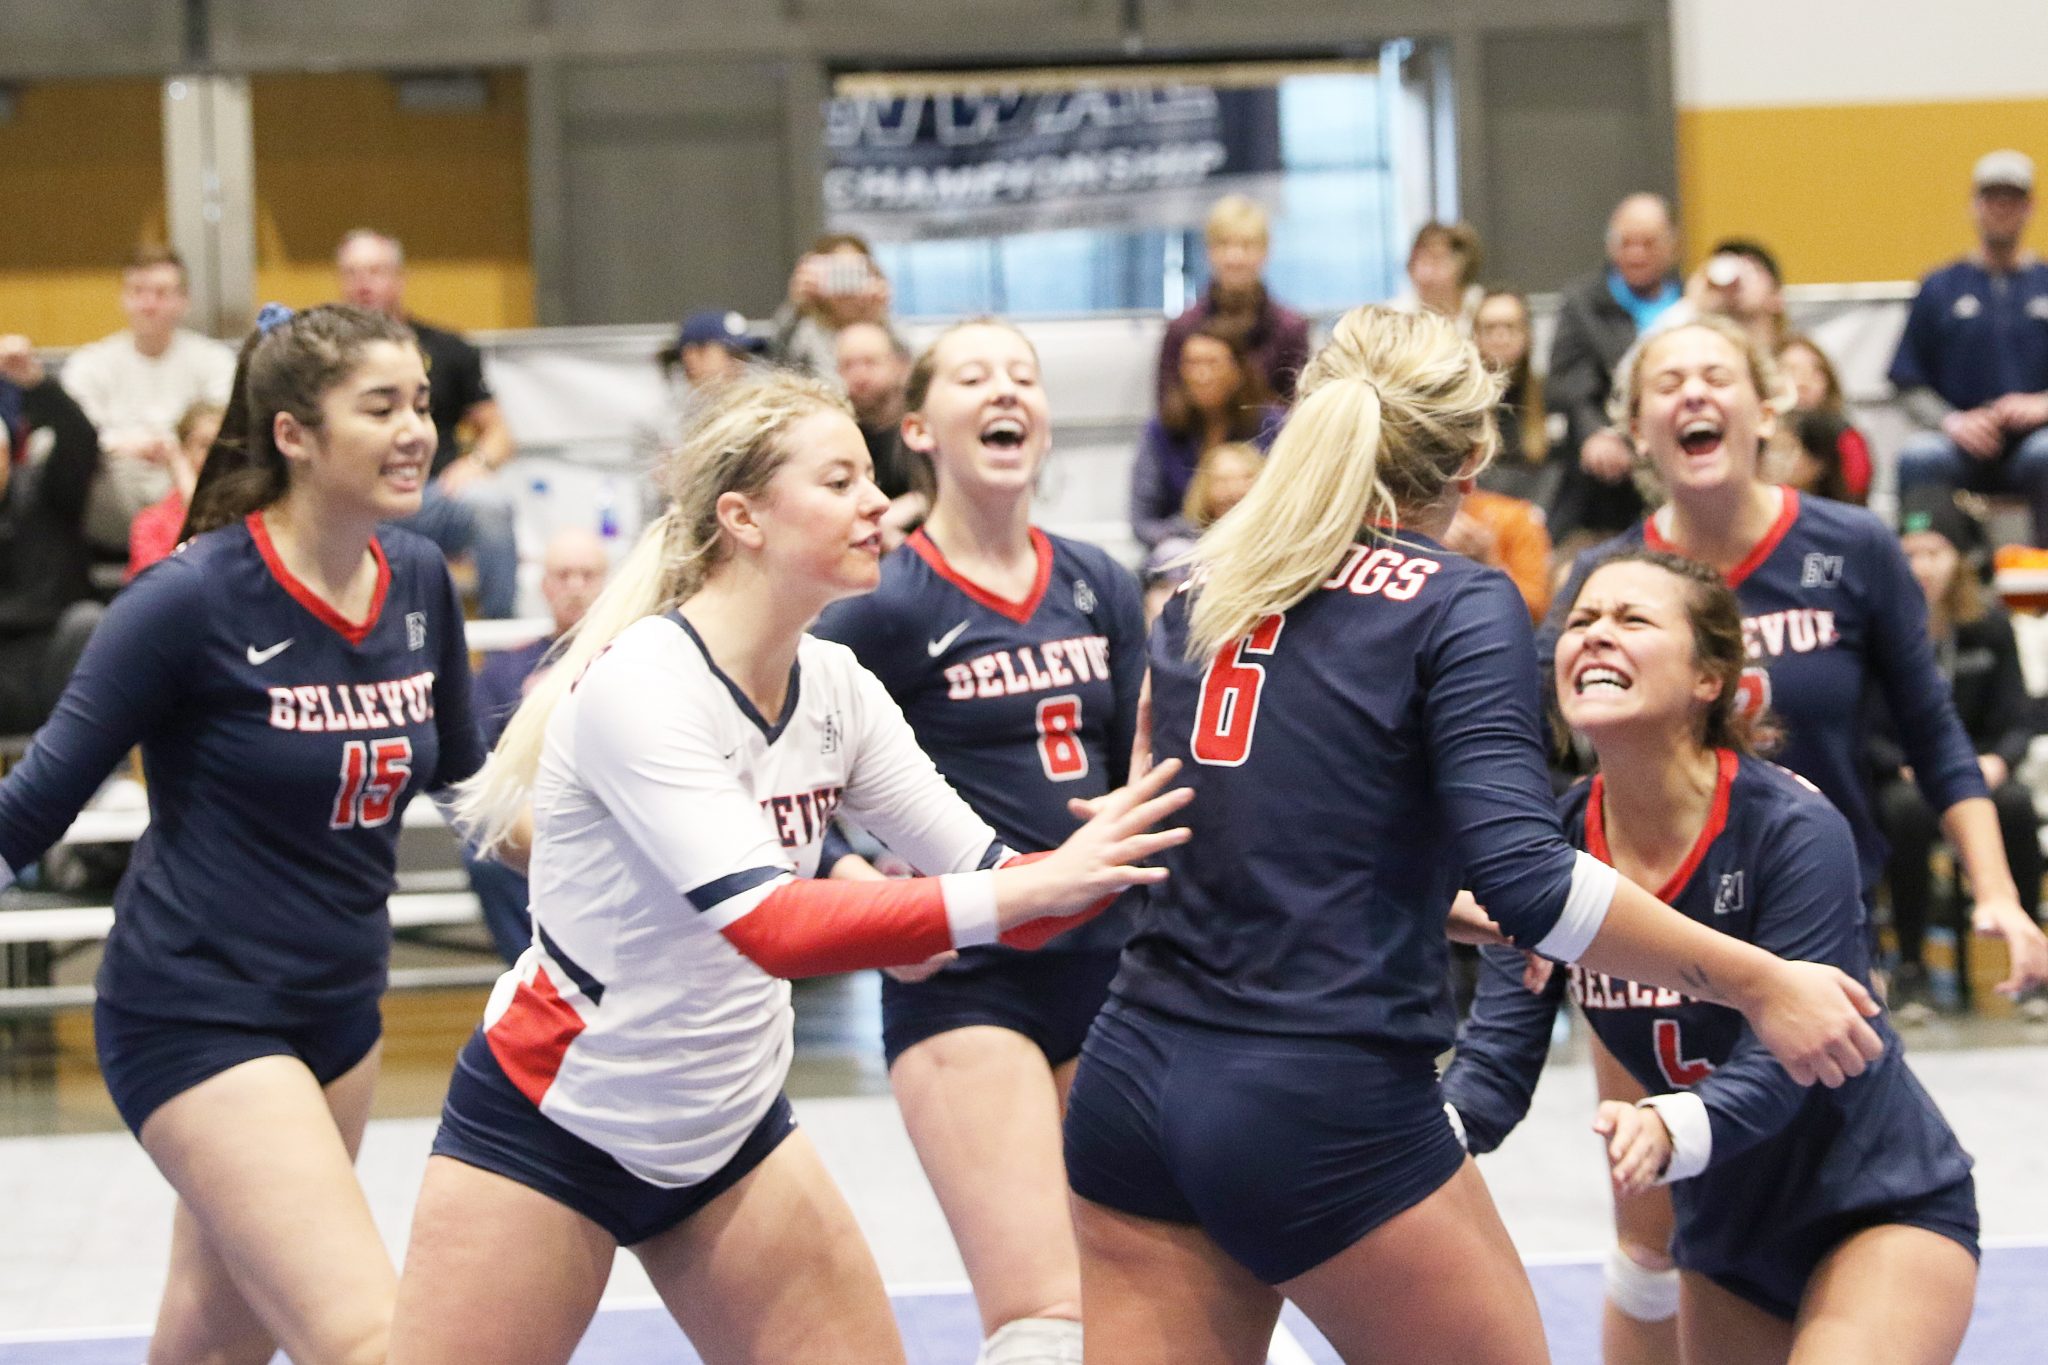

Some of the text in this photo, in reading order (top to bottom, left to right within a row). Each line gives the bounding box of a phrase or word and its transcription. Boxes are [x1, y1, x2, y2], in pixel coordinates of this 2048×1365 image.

[822, 140, 1228, 208] CHAMPIONSHIP
[267, 671, 436, 732] BELLEVU
[943, 636, 1111, 700] BELLEVU
[1190, 612, 1286, 768] 6
[1035, 693, 1089, 782] 8
[328, 736, 412, 831] 15
